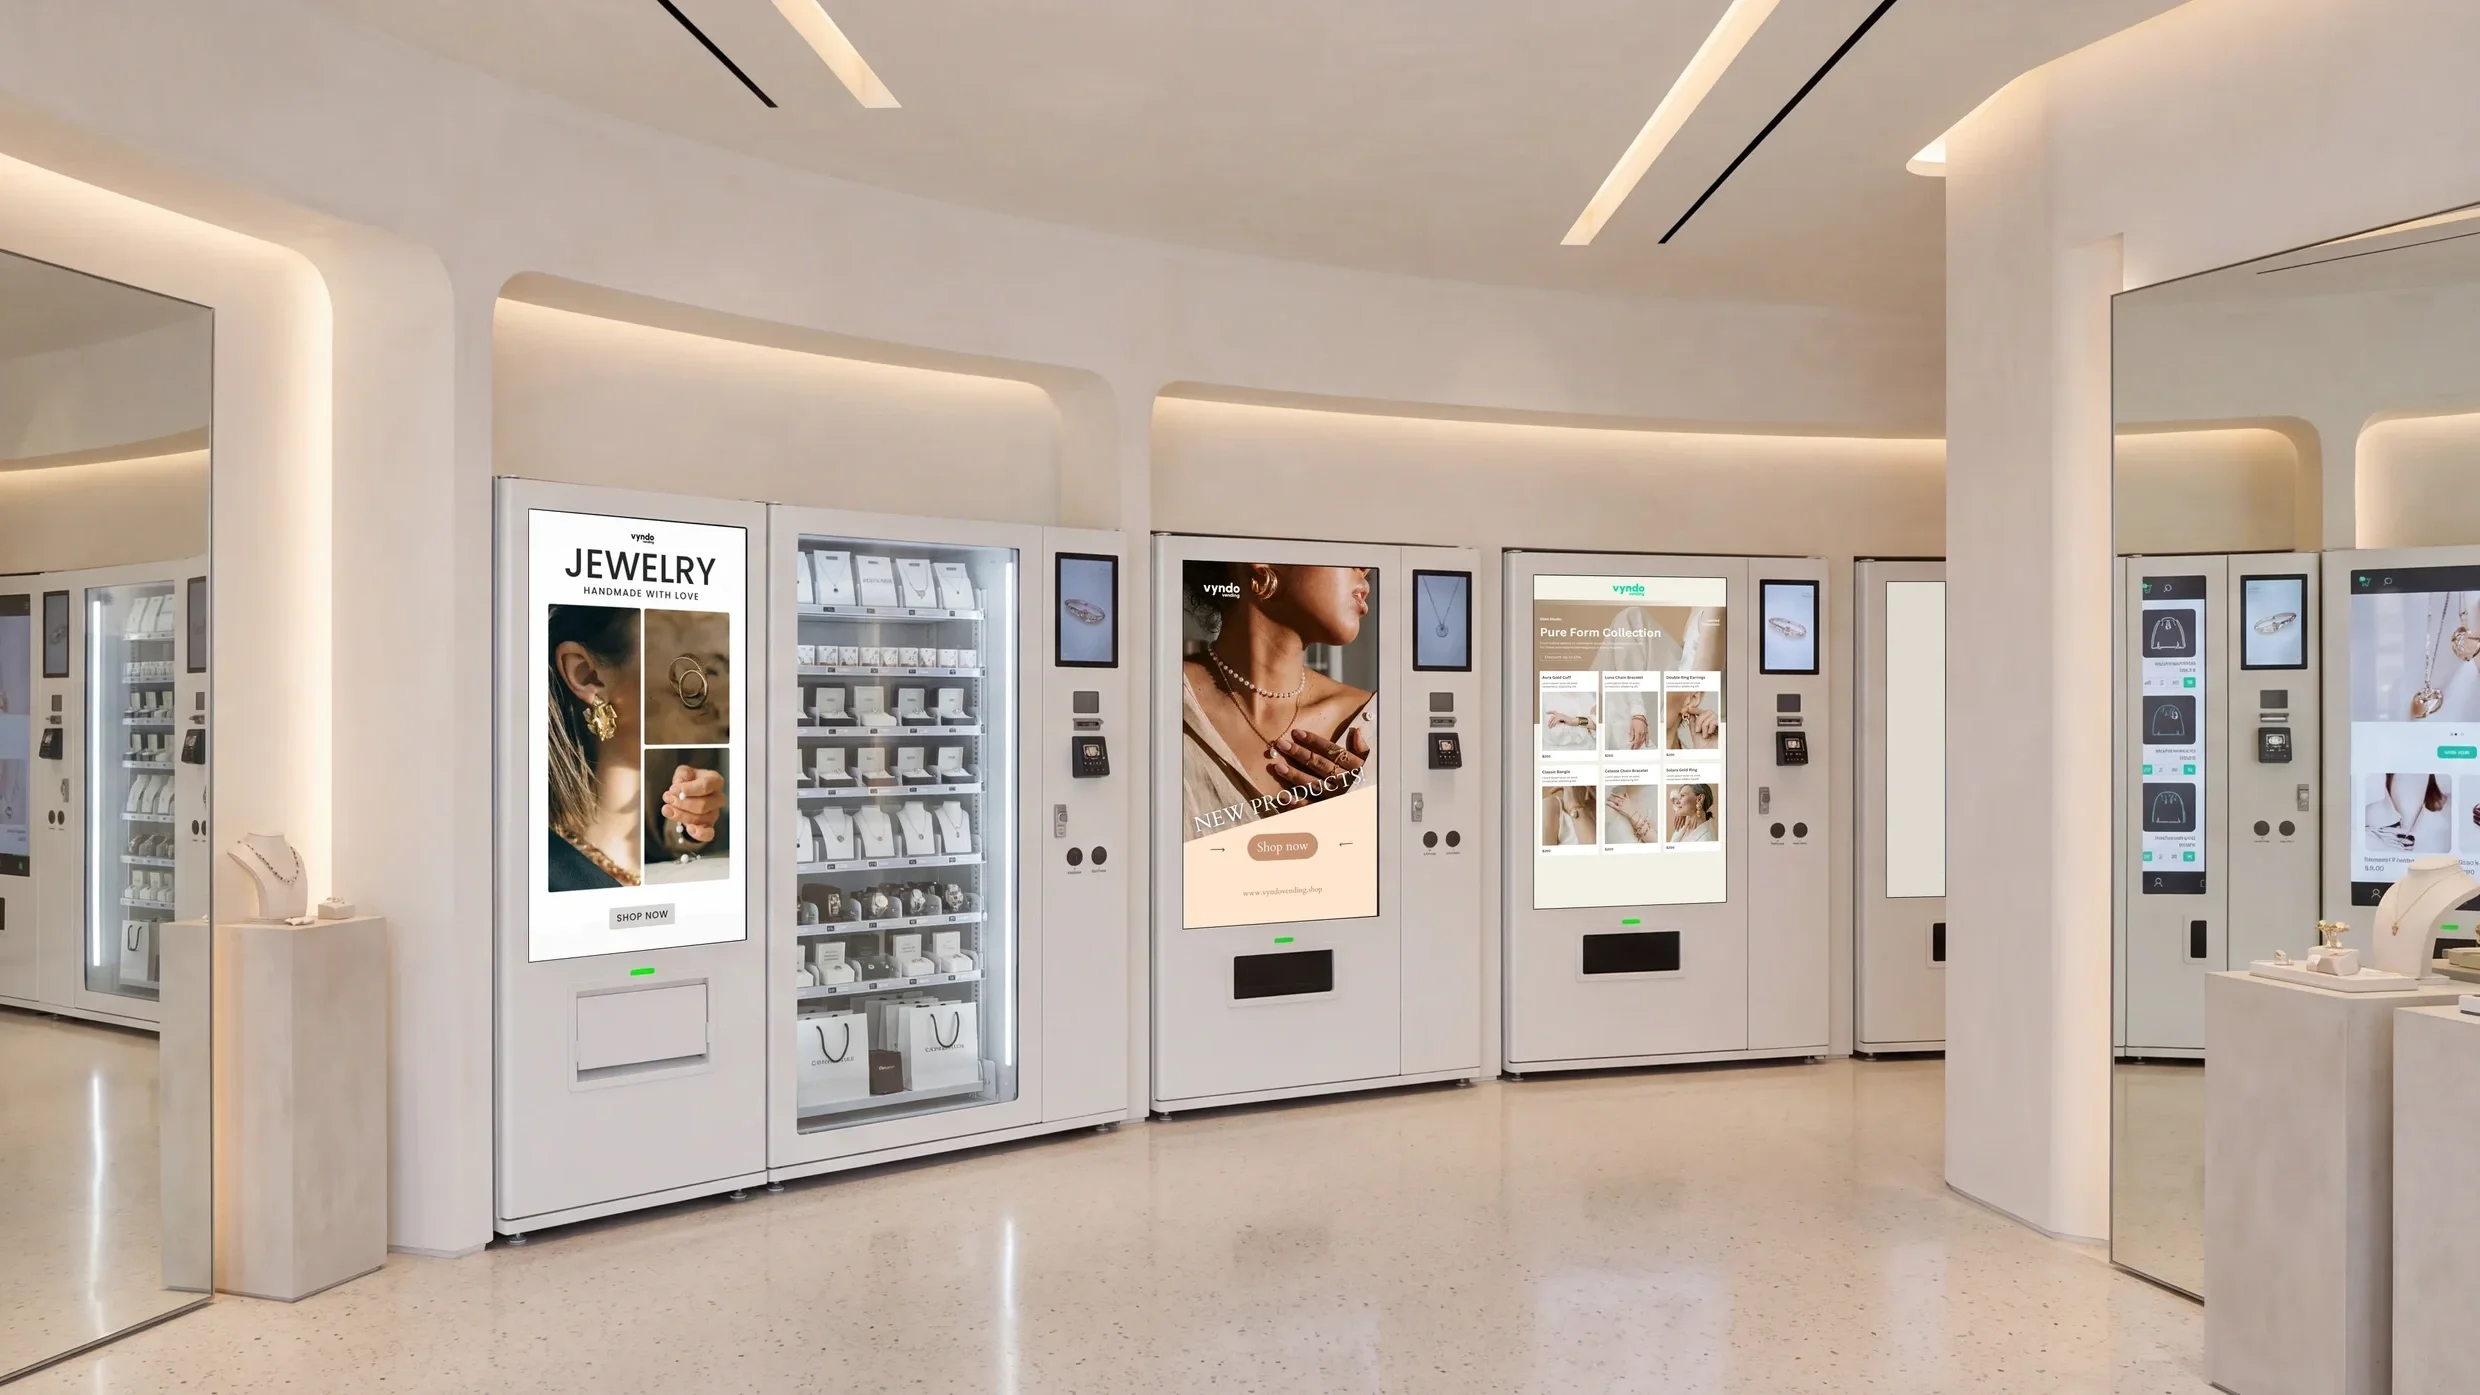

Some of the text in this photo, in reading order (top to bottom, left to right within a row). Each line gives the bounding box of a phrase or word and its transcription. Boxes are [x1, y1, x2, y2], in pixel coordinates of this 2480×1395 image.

[631, 533, 654, 542] vyndo
[565, 548, 716, 585] JEWELRY
[583, 586, 699, 601] HANDMADE WITH LOVE
[1203, 582, 1241, 596] vyndo
[1612, 583, 1645, 594] vyndo
[1540, 627, 1662, 638] Pure Form Collection
[1194, 766, 1366, 832] NEW PRODUCTS!
[1257, 841, 1308, 855] Shop now
[1242, 885, 1323, 898] www.vyndovending.shop
[616, 909, 669, 923] SHOP NOW
